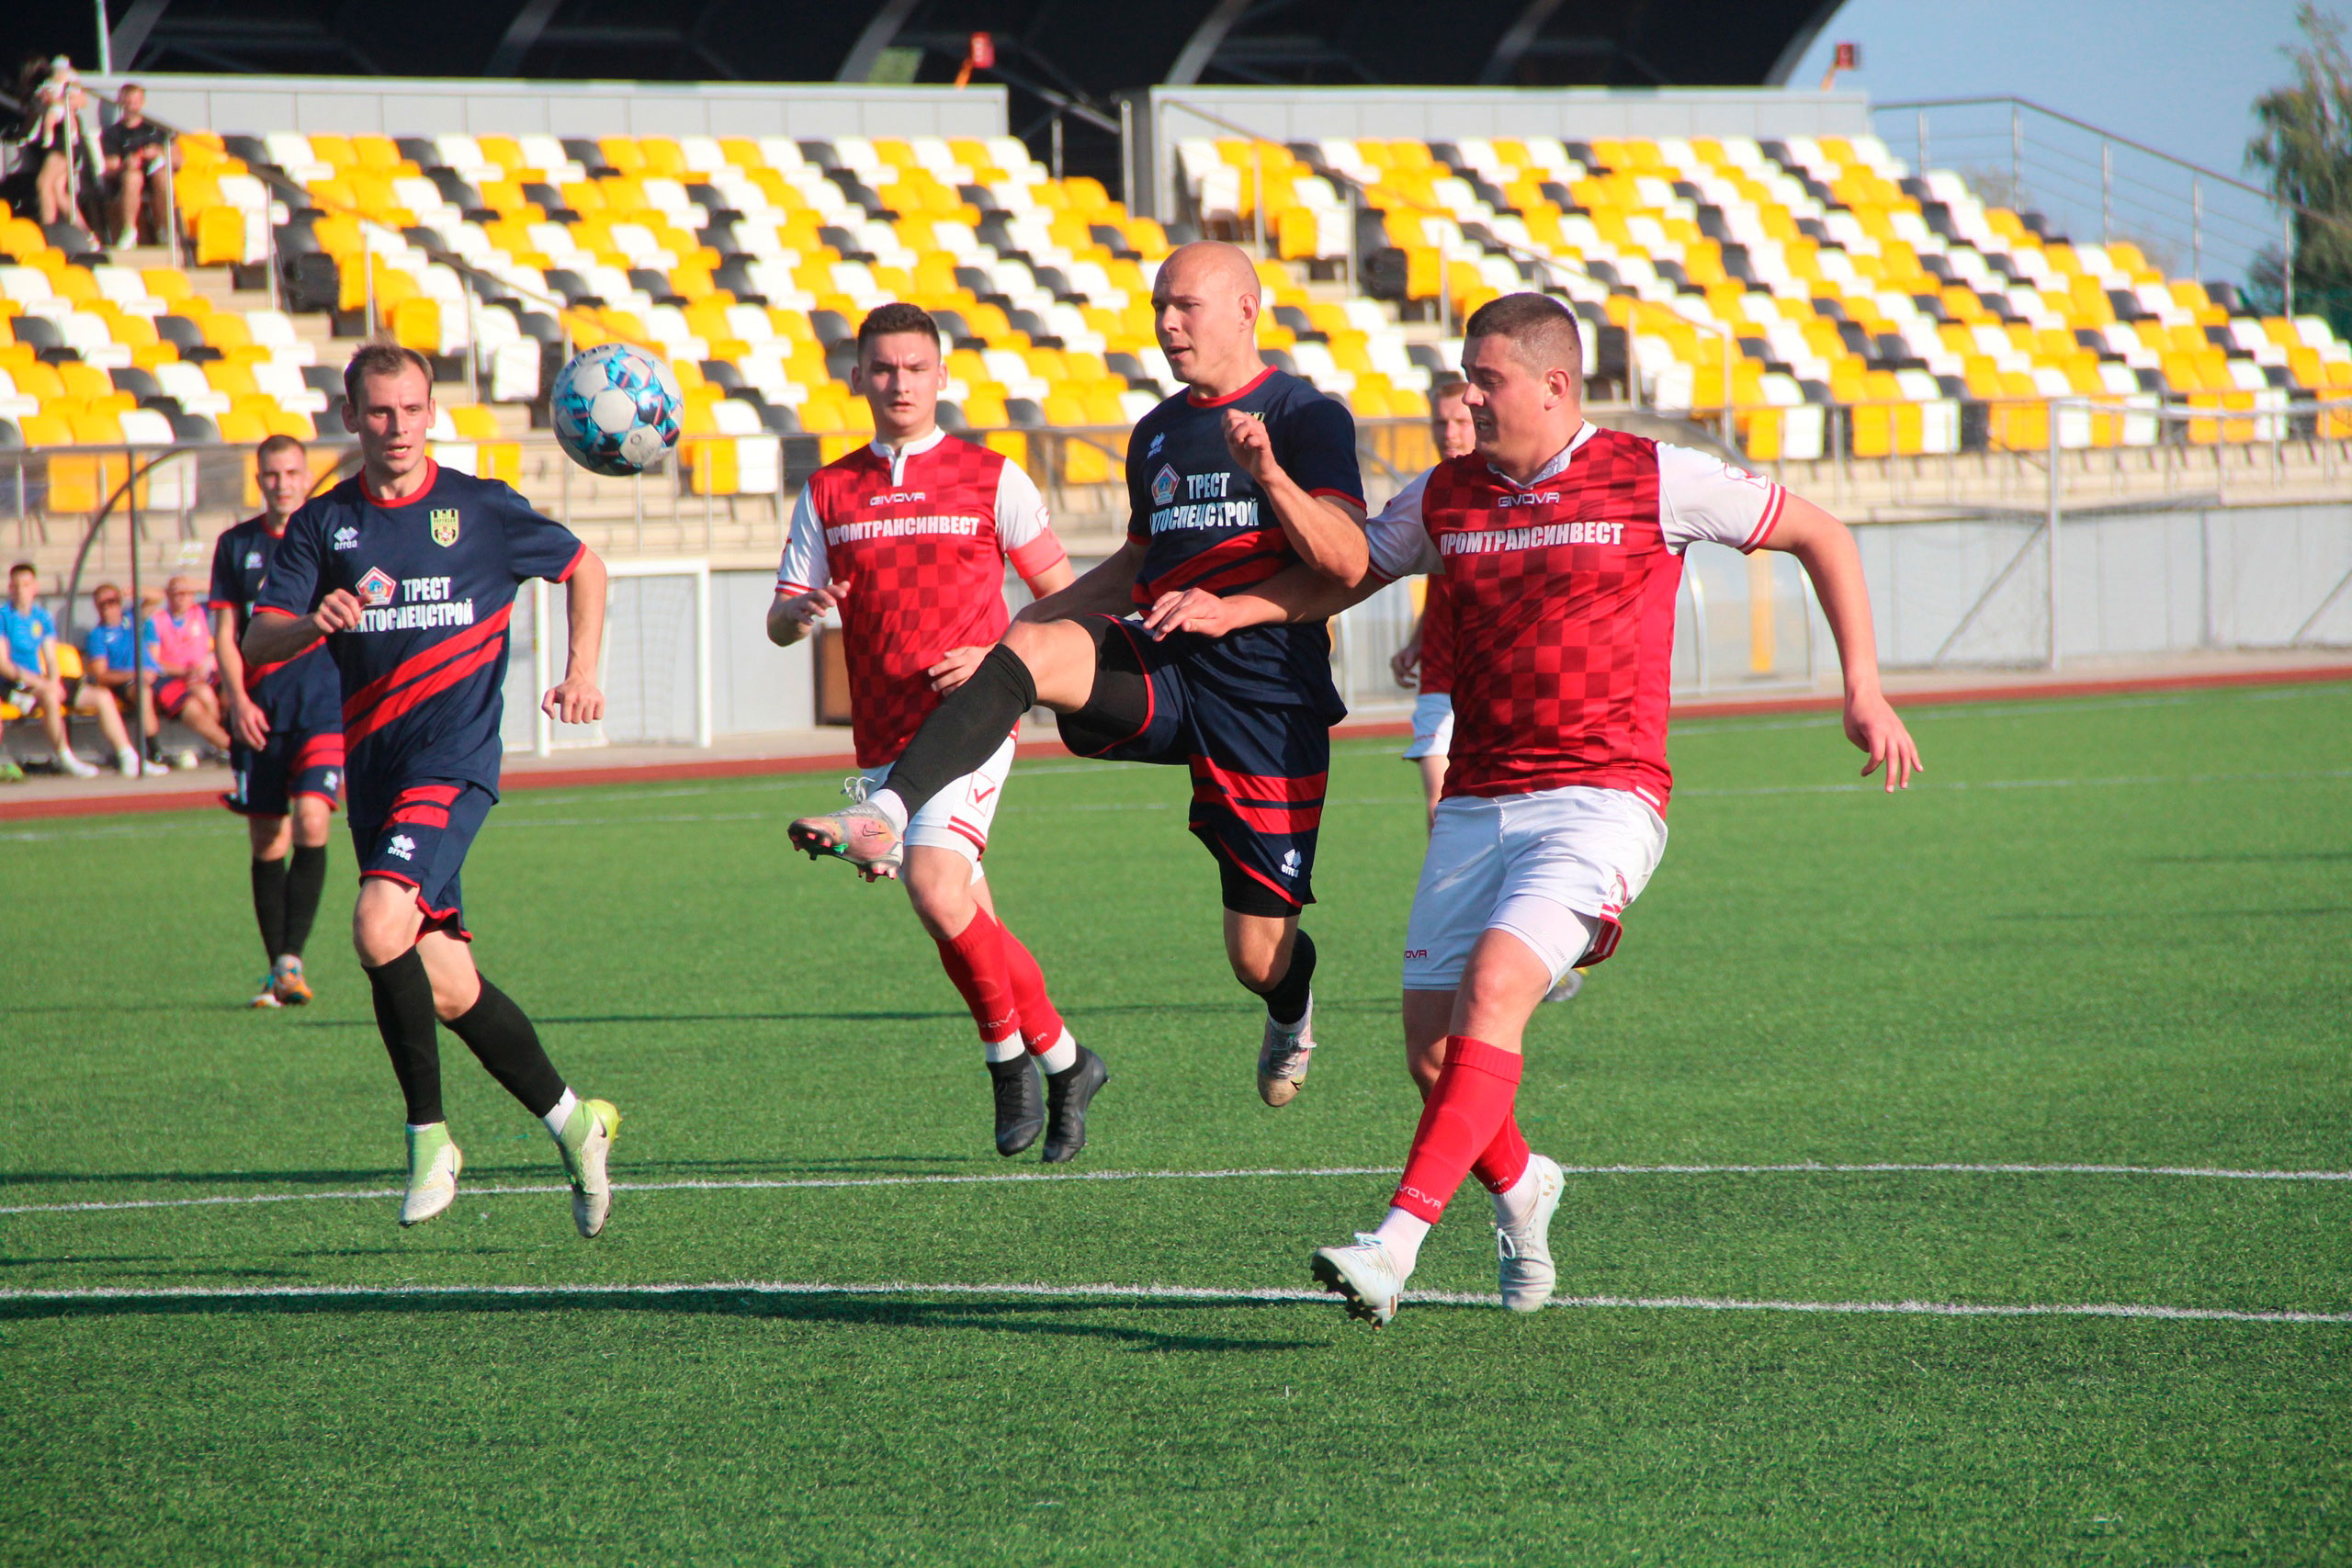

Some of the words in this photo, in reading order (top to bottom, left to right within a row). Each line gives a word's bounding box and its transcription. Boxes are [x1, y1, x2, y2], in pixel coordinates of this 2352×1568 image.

[870, 491, 926, 506] GIVOVA
[1187, 472, 1231, 500] ТРЕСТ
[1498, 491, 1560, 508] GIVOVA
[1149, 497, 1260, 536] ХТОСПЕЦСТРОЙ
[827, 515, 980, 547] ПРОМТРАНСИНВЕСТ
[1440, 521, 1624, 556] ПРОМТРАНСИНВЕСТ
[401, 576, 451, 603] ТРЕСТ
[343, 597, 474, 634] ХТОСПЕЦСТРОЙ
[1404, 949, 1428, 959] OVA
[1398, 1183, 1442, 1211] VOVA
